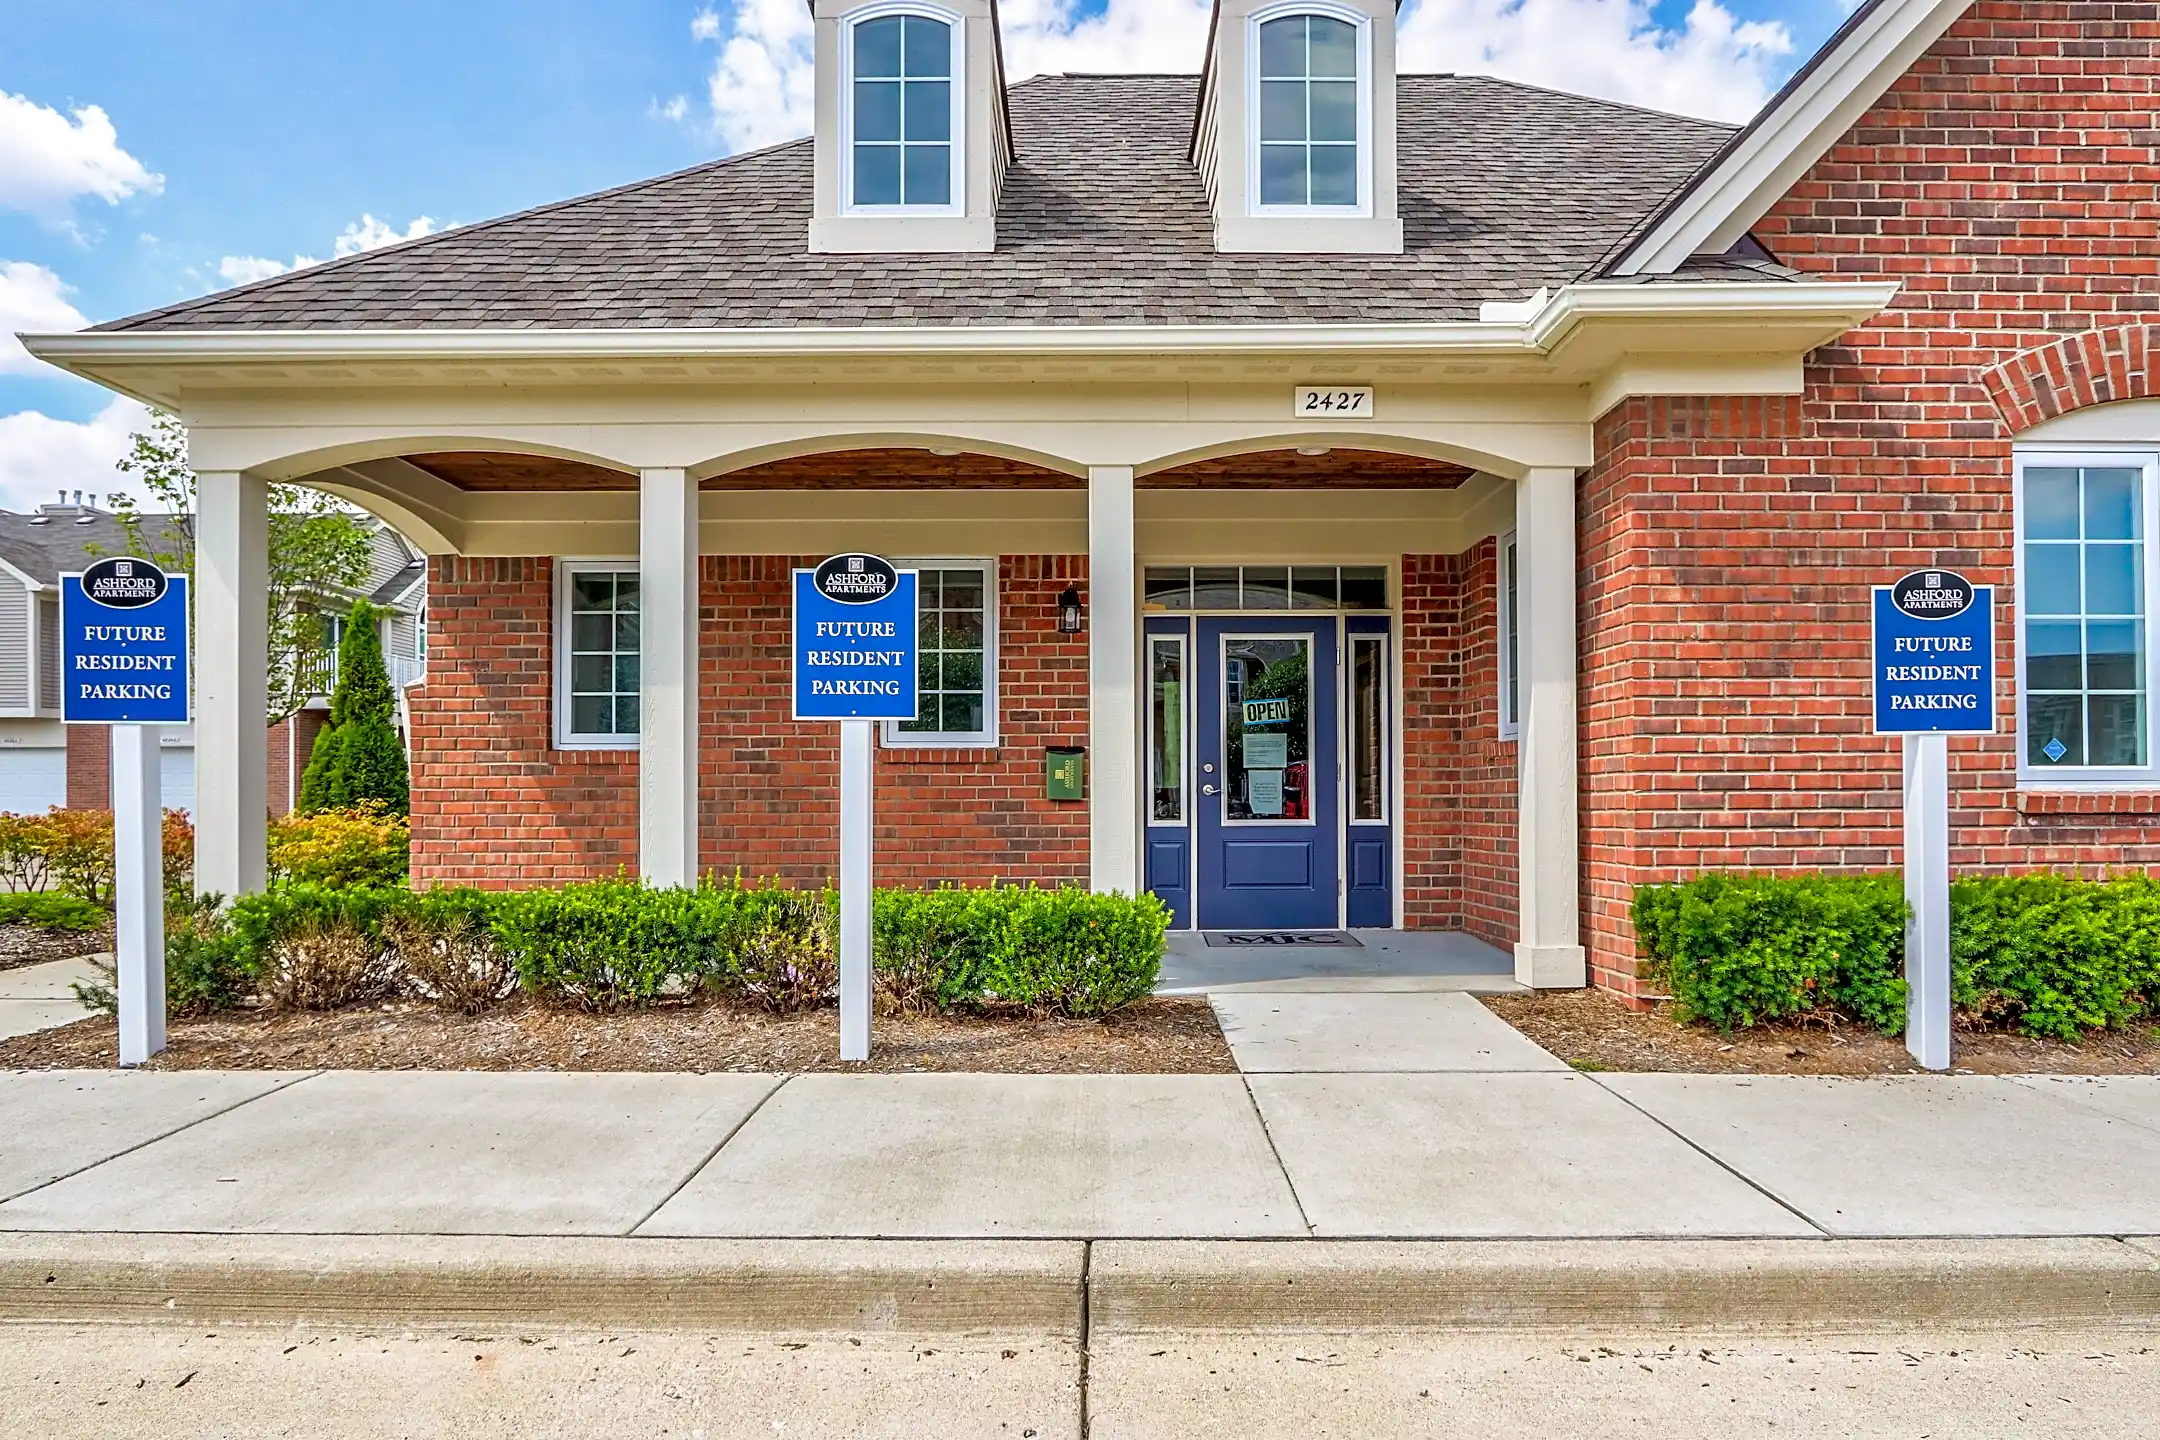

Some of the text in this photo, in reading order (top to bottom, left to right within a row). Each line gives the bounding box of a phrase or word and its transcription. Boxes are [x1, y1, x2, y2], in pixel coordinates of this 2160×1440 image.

[1305, 392, 1365, 411] 2427
[93, 578, 156, 588] ASHFORD
[825, 573, 886, 584] ASHFORD
[93, 590, 156, 598] APARTMENTS
[825, 585, 886, 594] APARTMENTS
[1903, 589, 1963, 600] ASHFORD
[1903, 601, 1963, 609] APARTMENTS
[84, 626, 166, 641] FUTURE
[816, 622, 896, 637] FUTURE
[1894, 637, 1973, 652] FUTURE
[75, 655, 176, 670] RESIDENT
[807, 651, 905, 666] RESIDENT
[1886, 665, 1982, 681] RESIDENT
[80, 684, 171, 699] PARKING
[811, 680, 900, 695] PARKING
[1890, 694, 1977, 710] PARKING
[1246, 700, 1287, 722] OPEN
